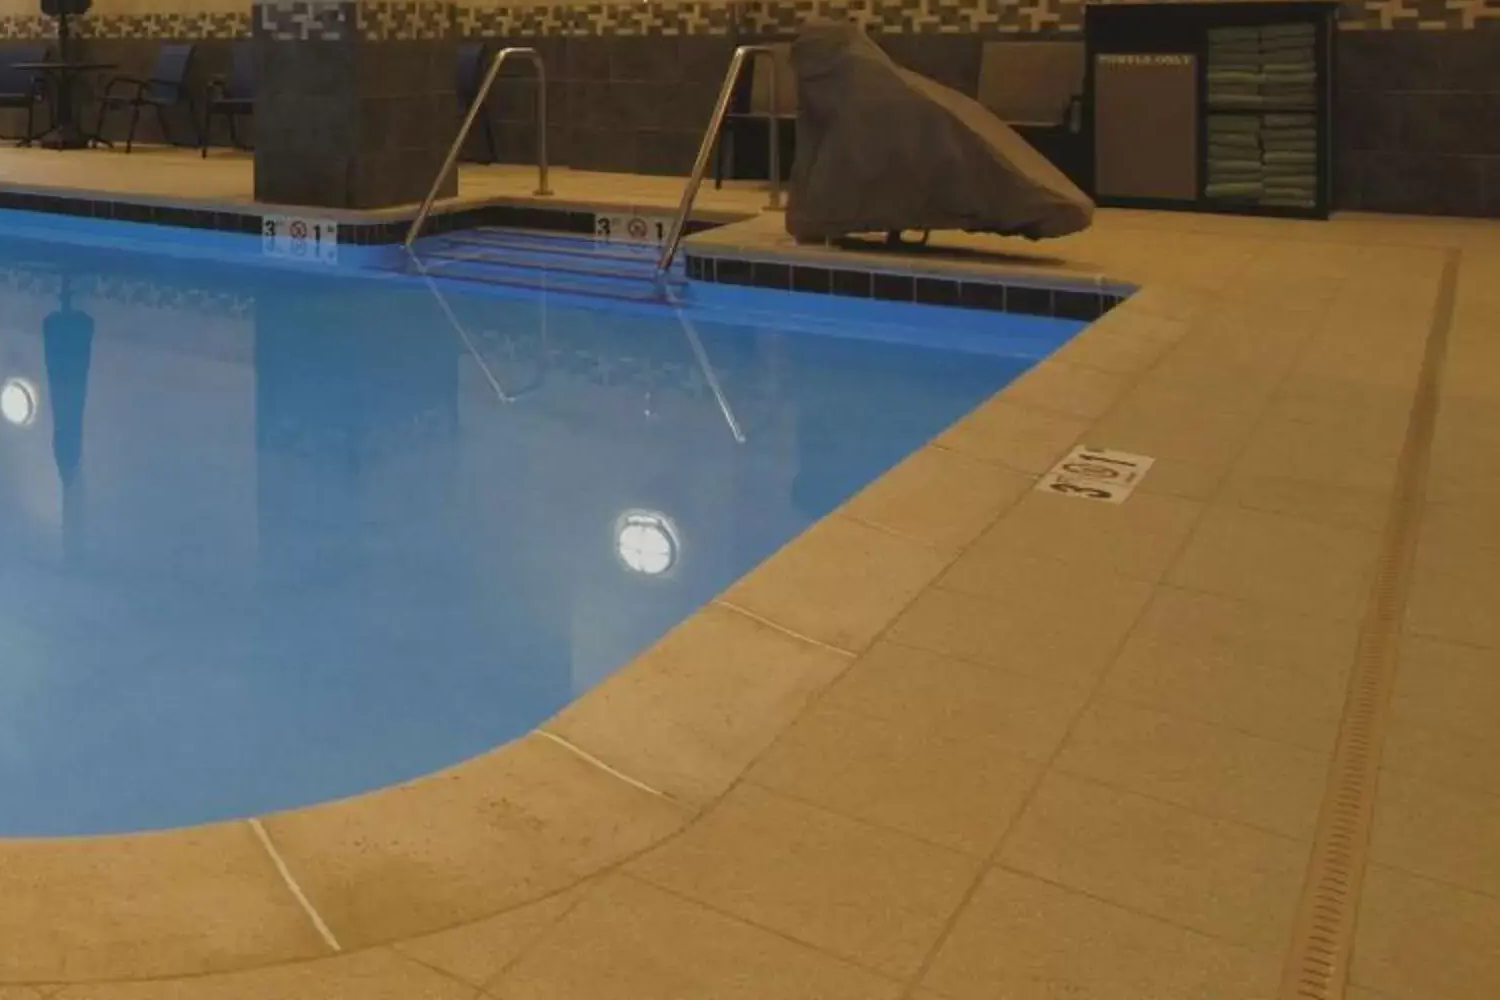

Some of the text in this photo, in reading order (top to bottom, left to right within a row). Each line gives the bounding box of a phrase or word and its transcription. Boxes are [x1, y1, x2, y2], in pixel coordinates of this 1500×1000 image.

[264, 219, 276, 236] 3
[597, 217, 611, 235] 3
[1049, 481, 1113, 499] 3
